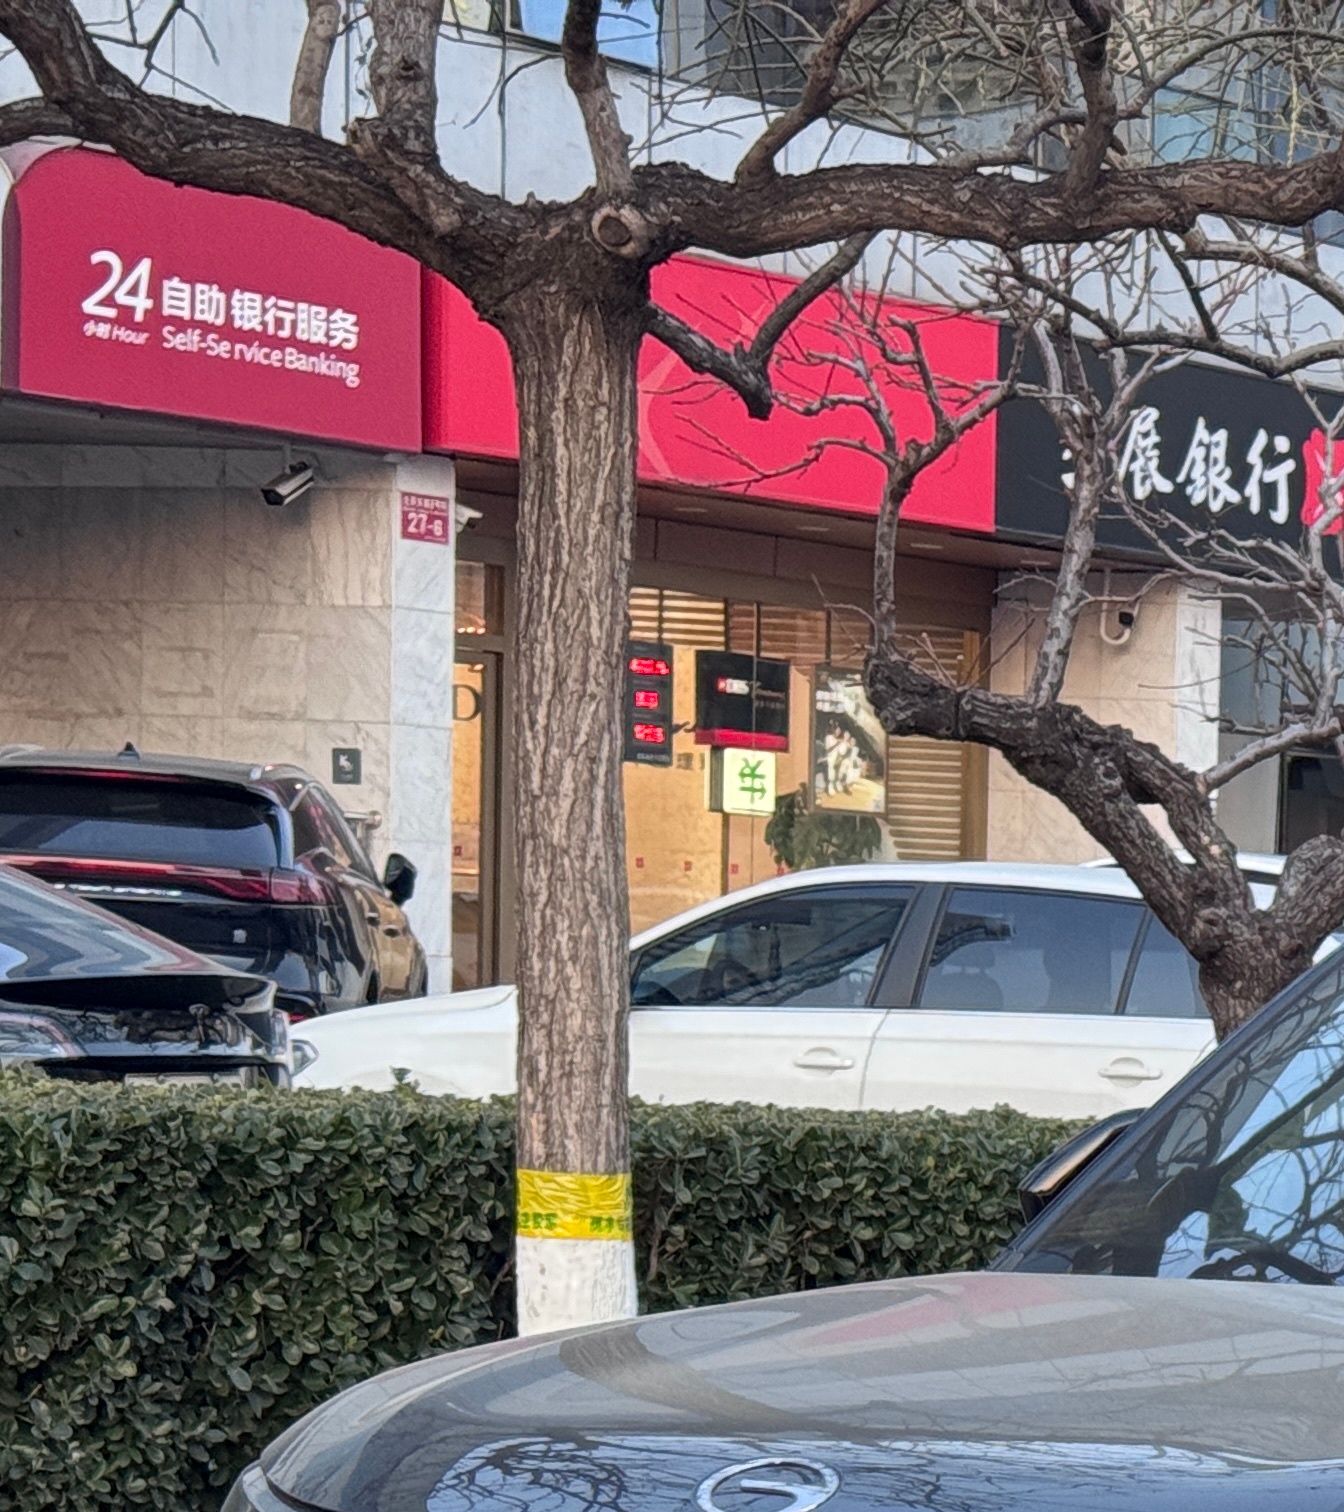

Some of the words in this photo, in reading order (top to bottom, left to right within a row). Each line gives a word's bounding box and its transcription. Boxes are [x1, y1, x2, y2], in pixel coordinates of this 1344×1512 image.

[81, 250, 154, 322] 24
[162, 277, 360, 350] 自助银行服务
[112, 325, 150, 345] Hour
[284, 347, 360, 388] Banking
